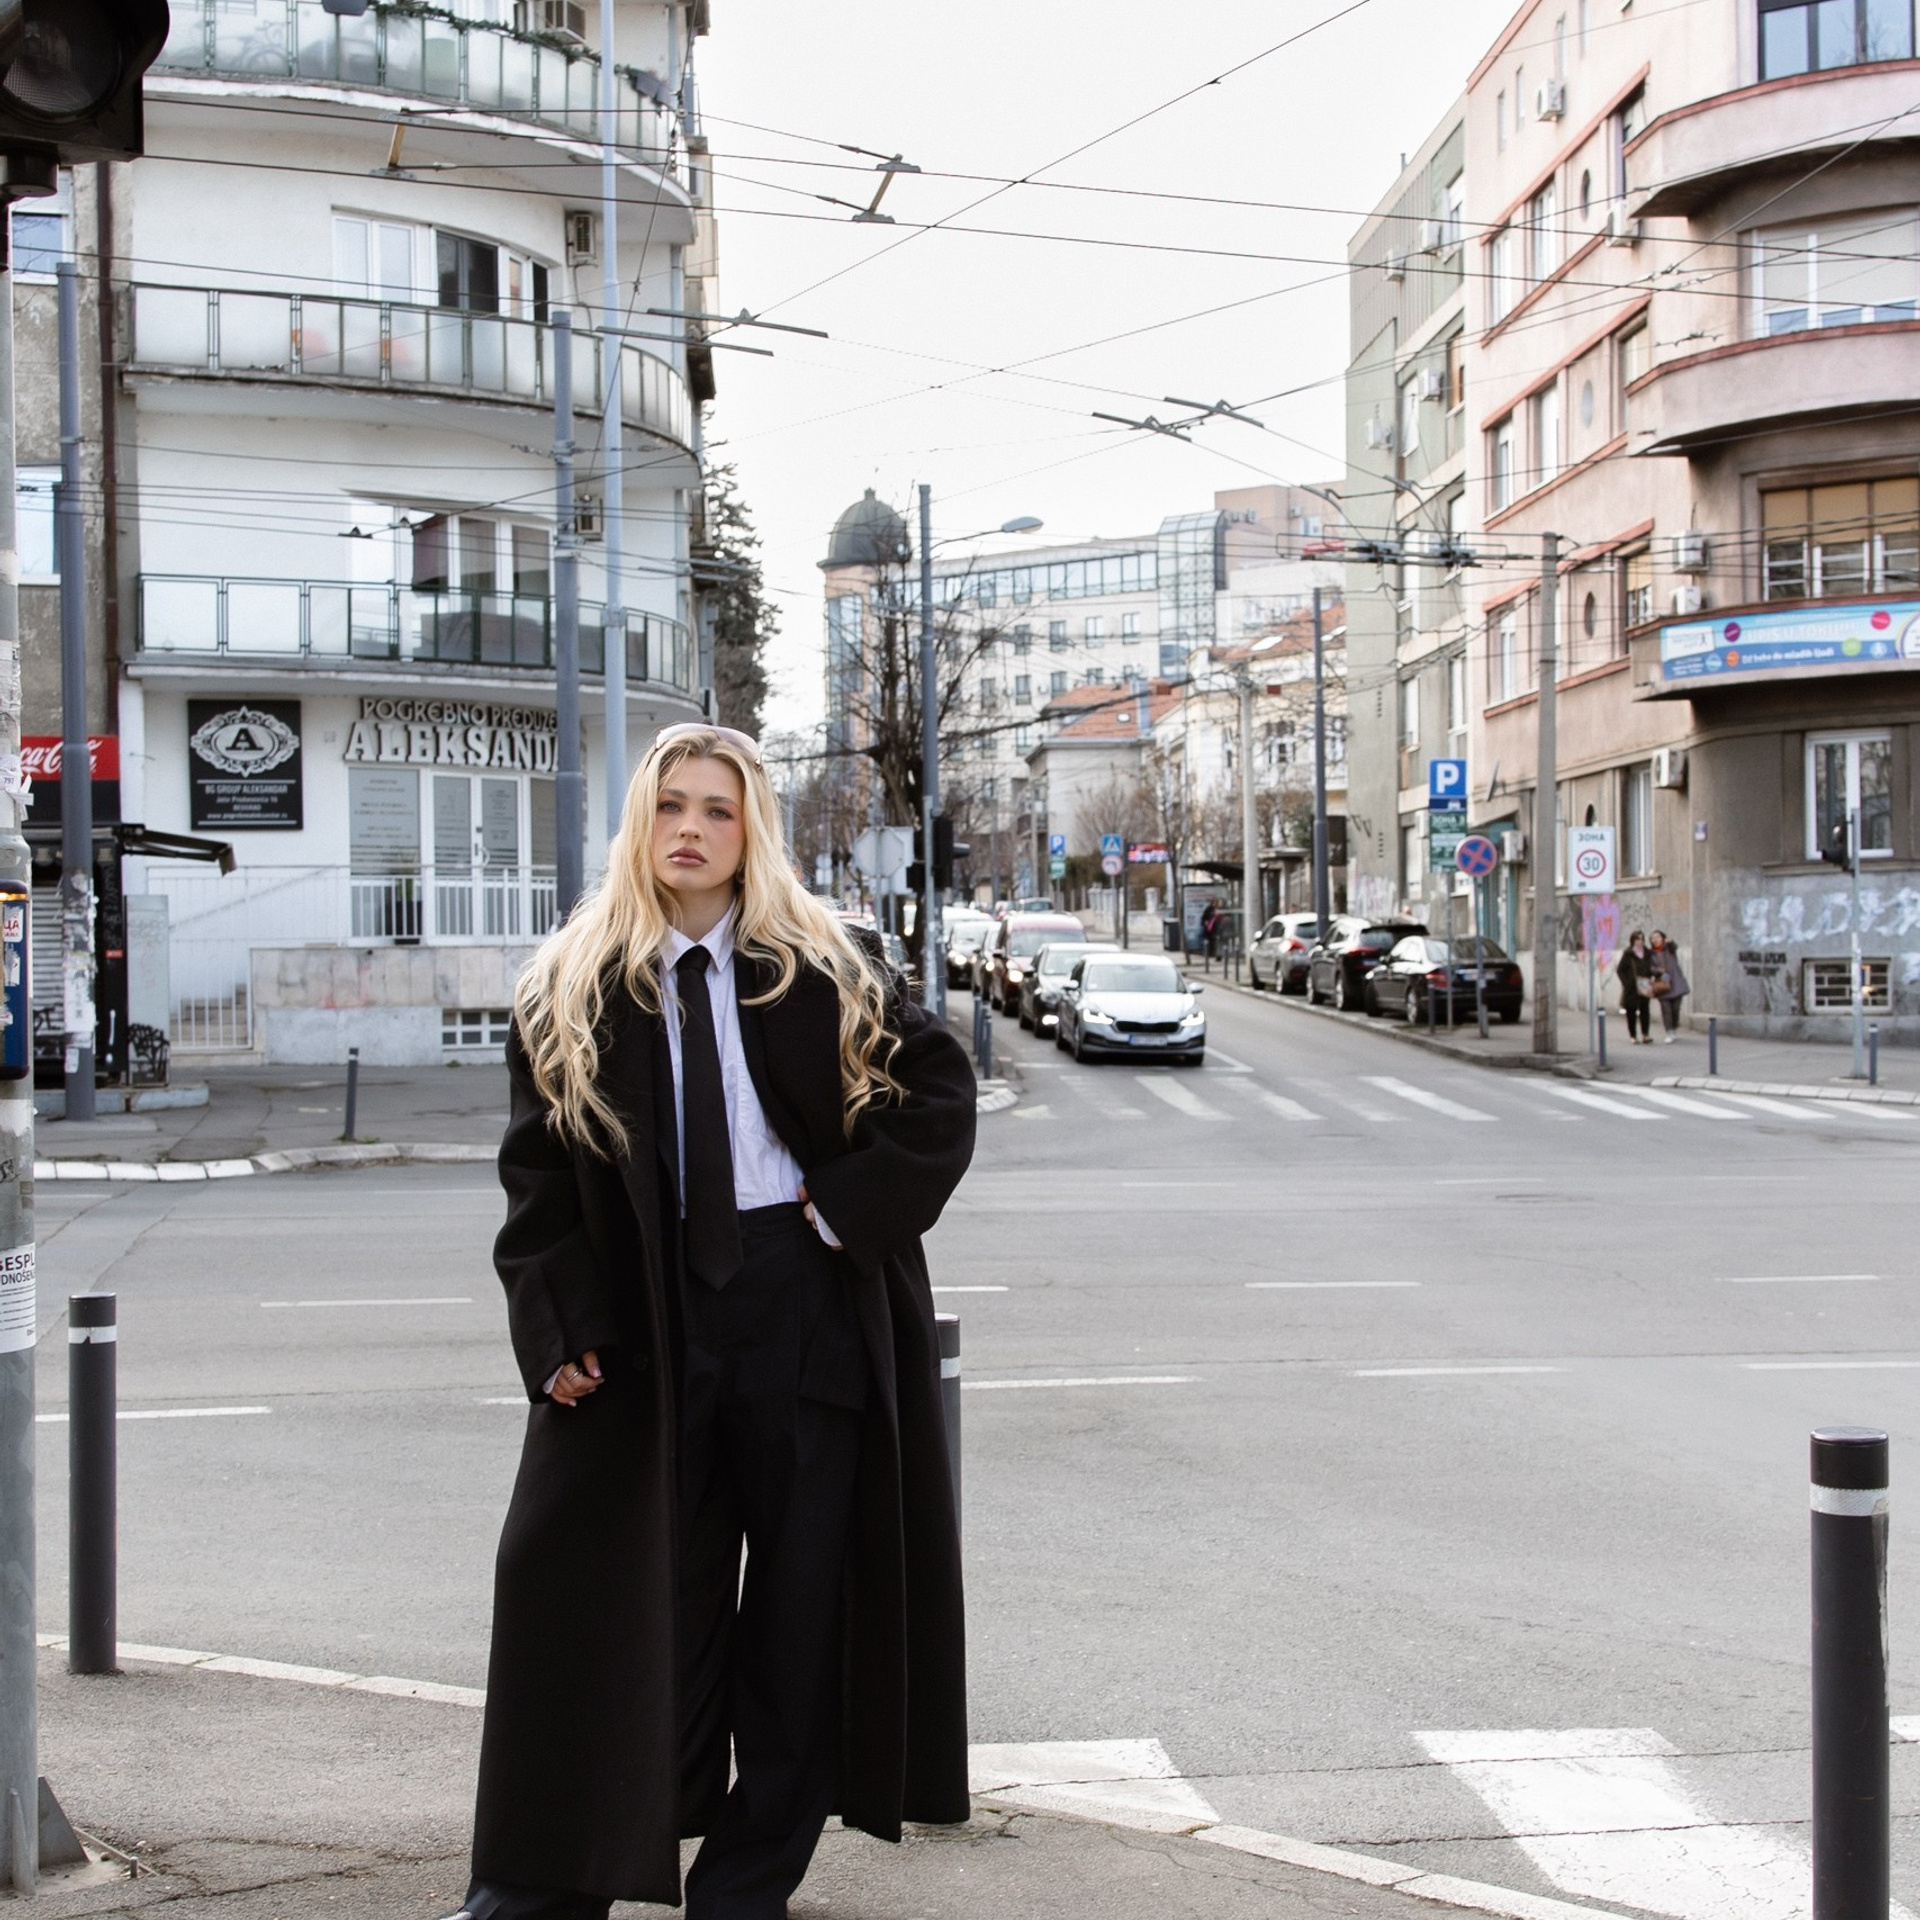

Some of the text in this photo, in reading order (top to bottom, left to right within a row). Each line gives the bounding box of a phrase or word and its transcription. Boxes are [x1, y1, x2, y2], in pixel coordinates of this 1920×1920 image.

[361, 698, 558, 733] POGREBNO PREDUZE
[225, 727, 264, 751] A
[345, 722, 558, 772] ALEKSAND
[1578, 833, 1605, 842] ЗОНА
[1583, 857, 1600, 871] 30
